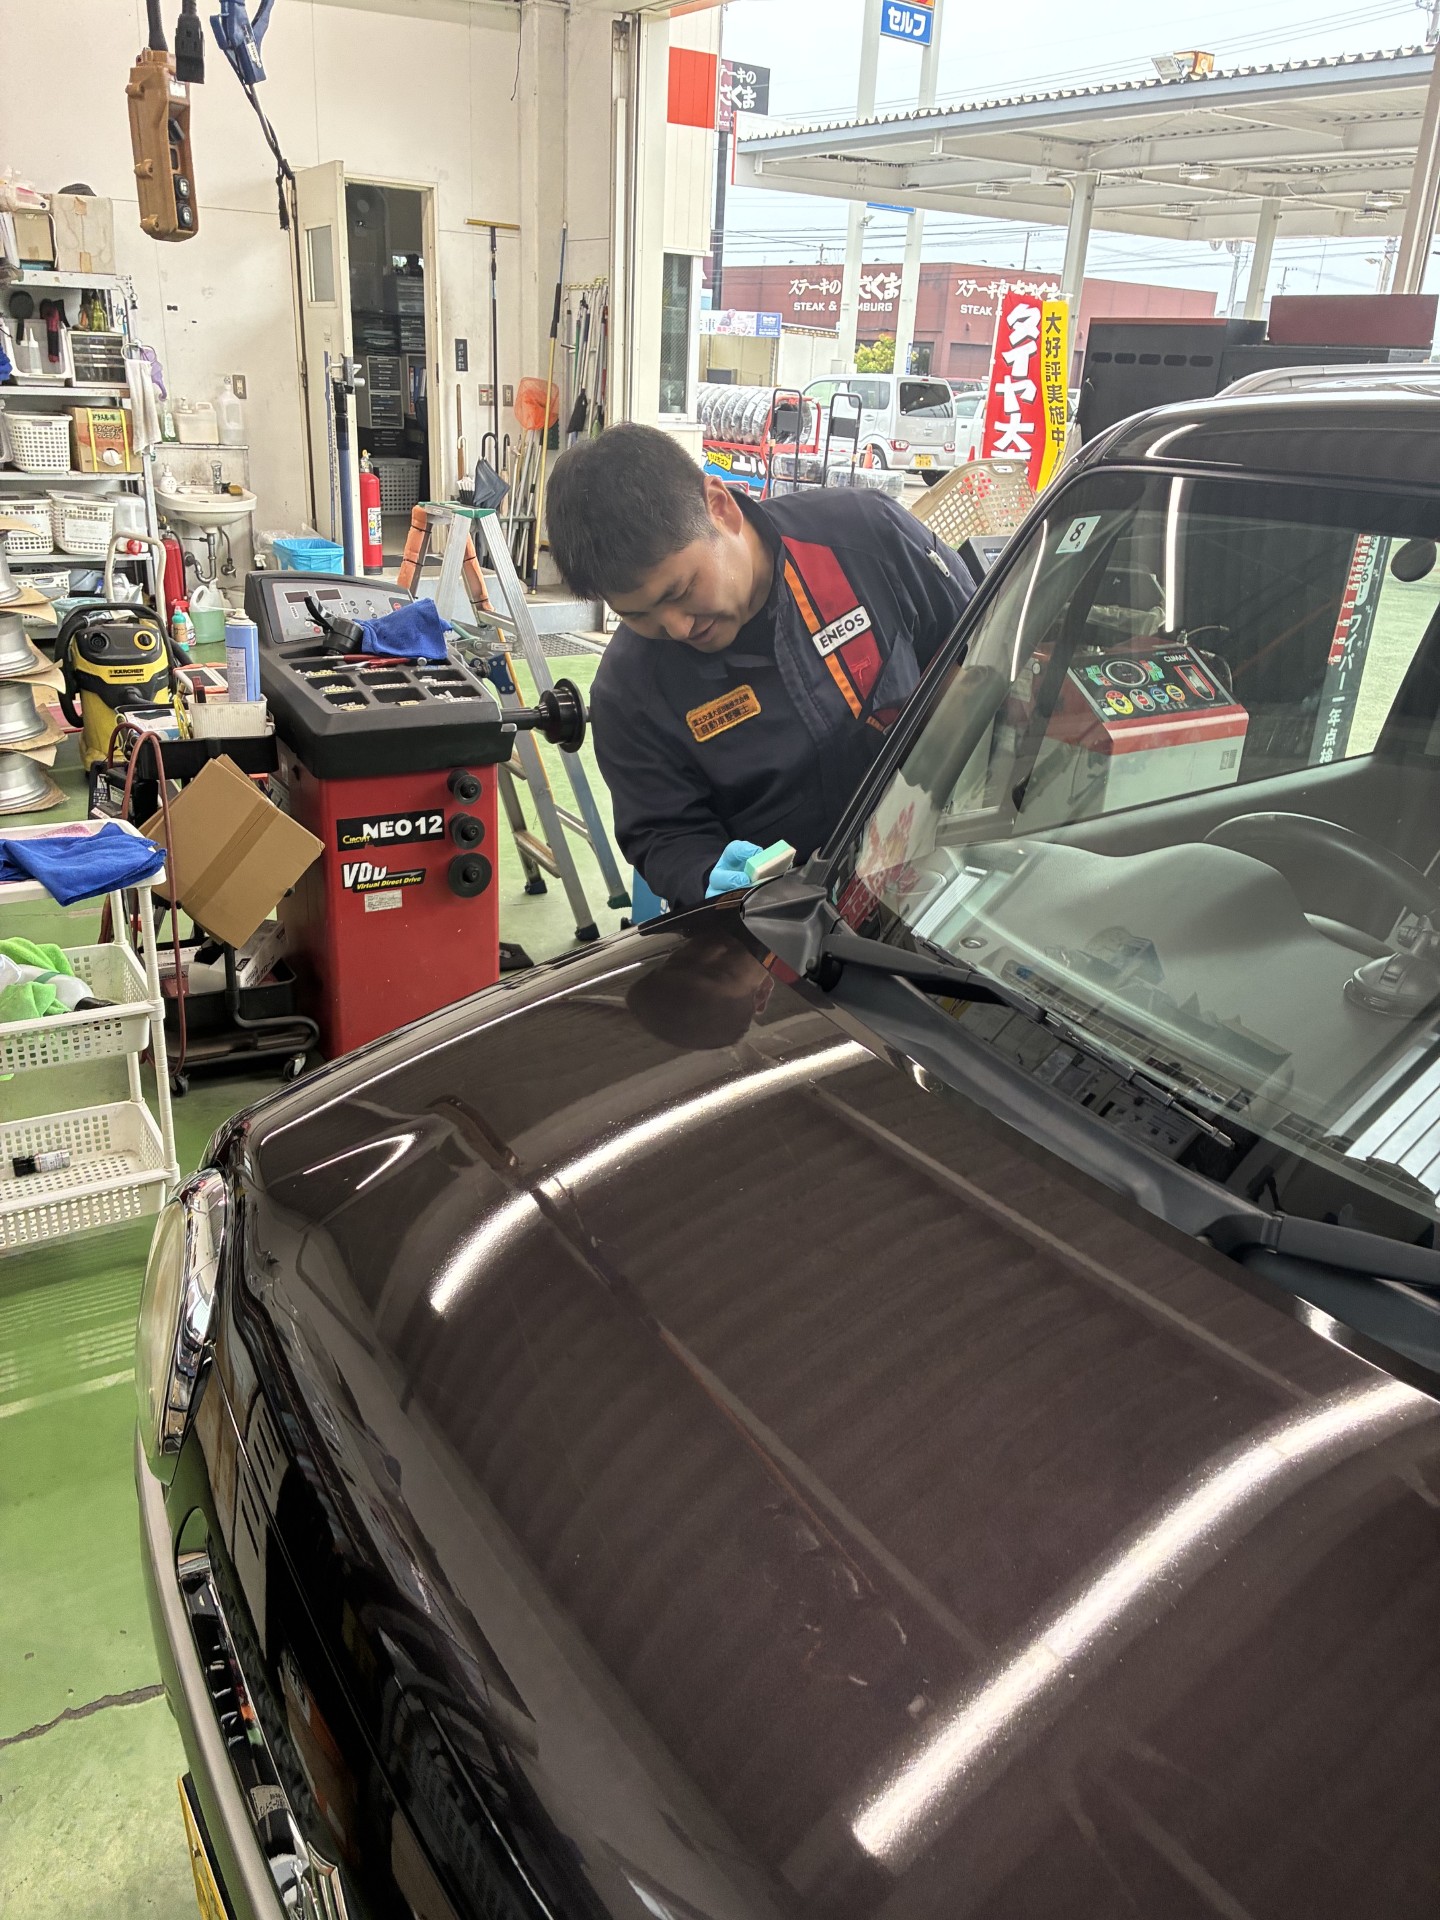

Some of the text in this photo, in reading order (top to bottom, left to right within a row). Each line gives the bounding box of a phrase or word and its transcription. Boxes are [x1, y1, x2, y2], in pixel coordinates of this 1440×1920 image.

[887, 6, 927, 37] セルフ
[788, 272, 903, 301] ステーキの さくま
[793, 301, 893, 312] STEAK & MBURG
[960, 304, 993, 316] STEAK
[1069, 521, 1087, 542] 8
[819, 613, 865, 649] ENEOS
[356, 876, 422, 891] Virtual Direct Drive
